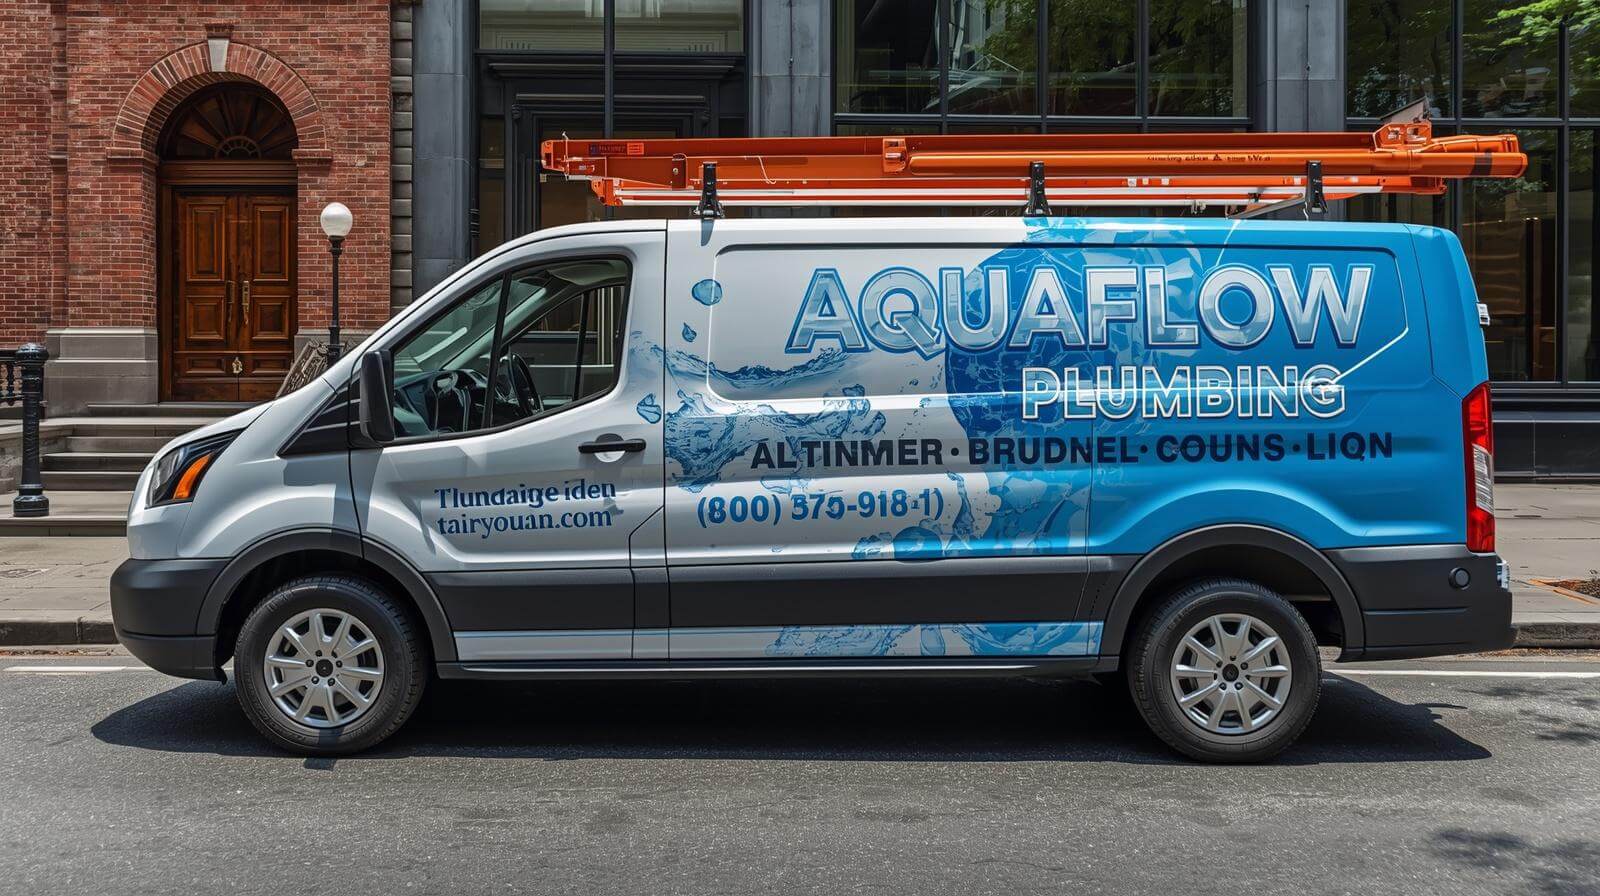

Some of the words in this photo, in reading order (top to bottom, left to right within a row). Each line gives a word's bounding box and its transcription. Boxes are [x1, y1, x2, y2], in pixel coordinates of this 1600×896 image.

[786, 266, 1374, 359] AQUAFLOW
[1021, 364, 1346, 421] PLUMBING
[697, 494, 782, 528] (800)
